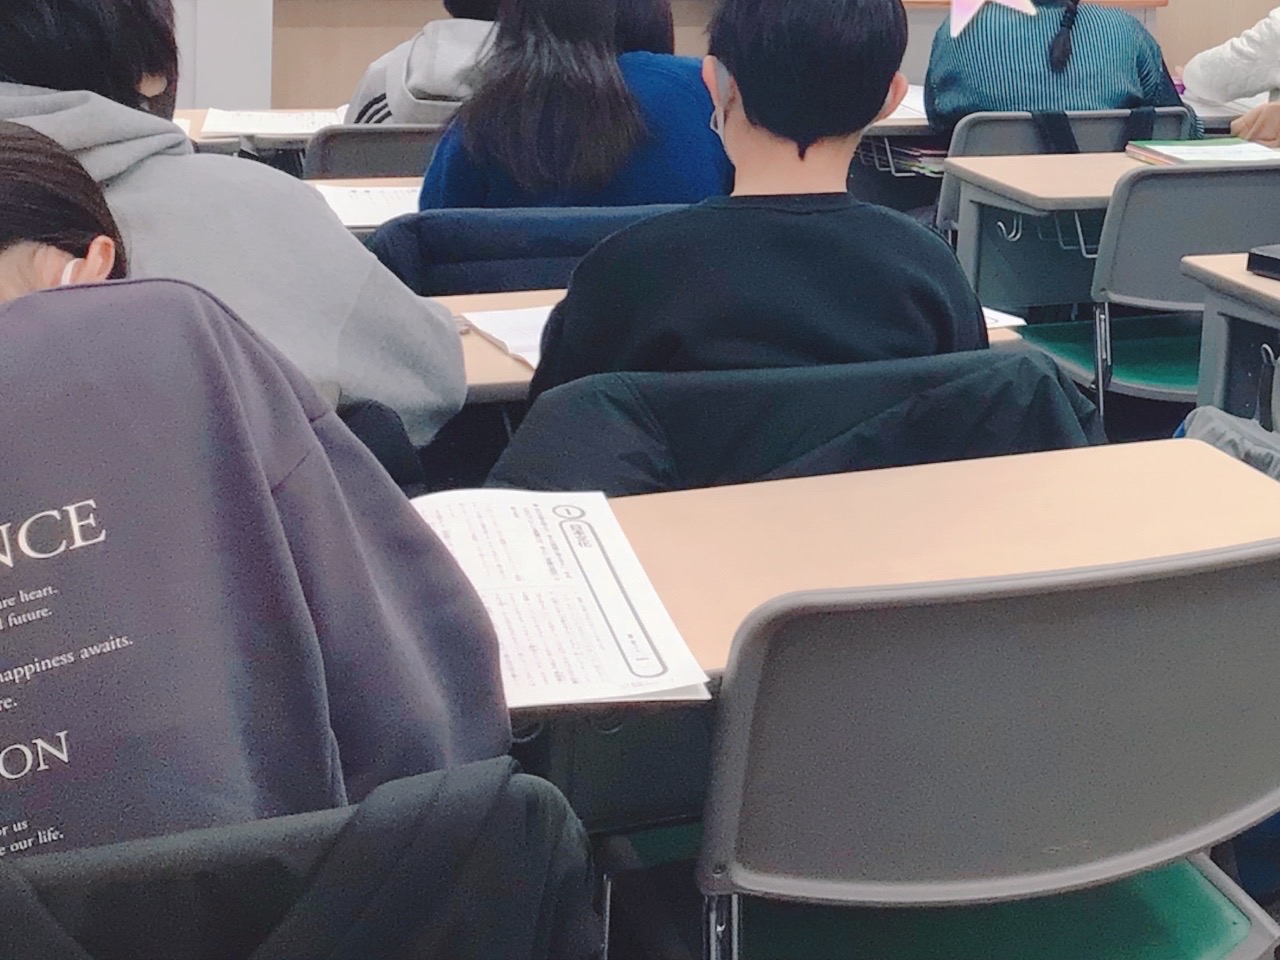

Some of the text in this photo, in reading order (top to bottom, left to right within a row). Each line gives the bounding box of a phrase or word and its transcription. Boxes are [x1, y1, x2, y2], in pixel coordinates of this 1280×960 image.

[19, 586, 58, 603] heart.
[7, 608, 53, 627] future.
[79, 635, 134, 659] awaits.
[12, 820, 29, 832] us
[10, 837, 34, 852] our
[37, 826, 64, 845] life.
